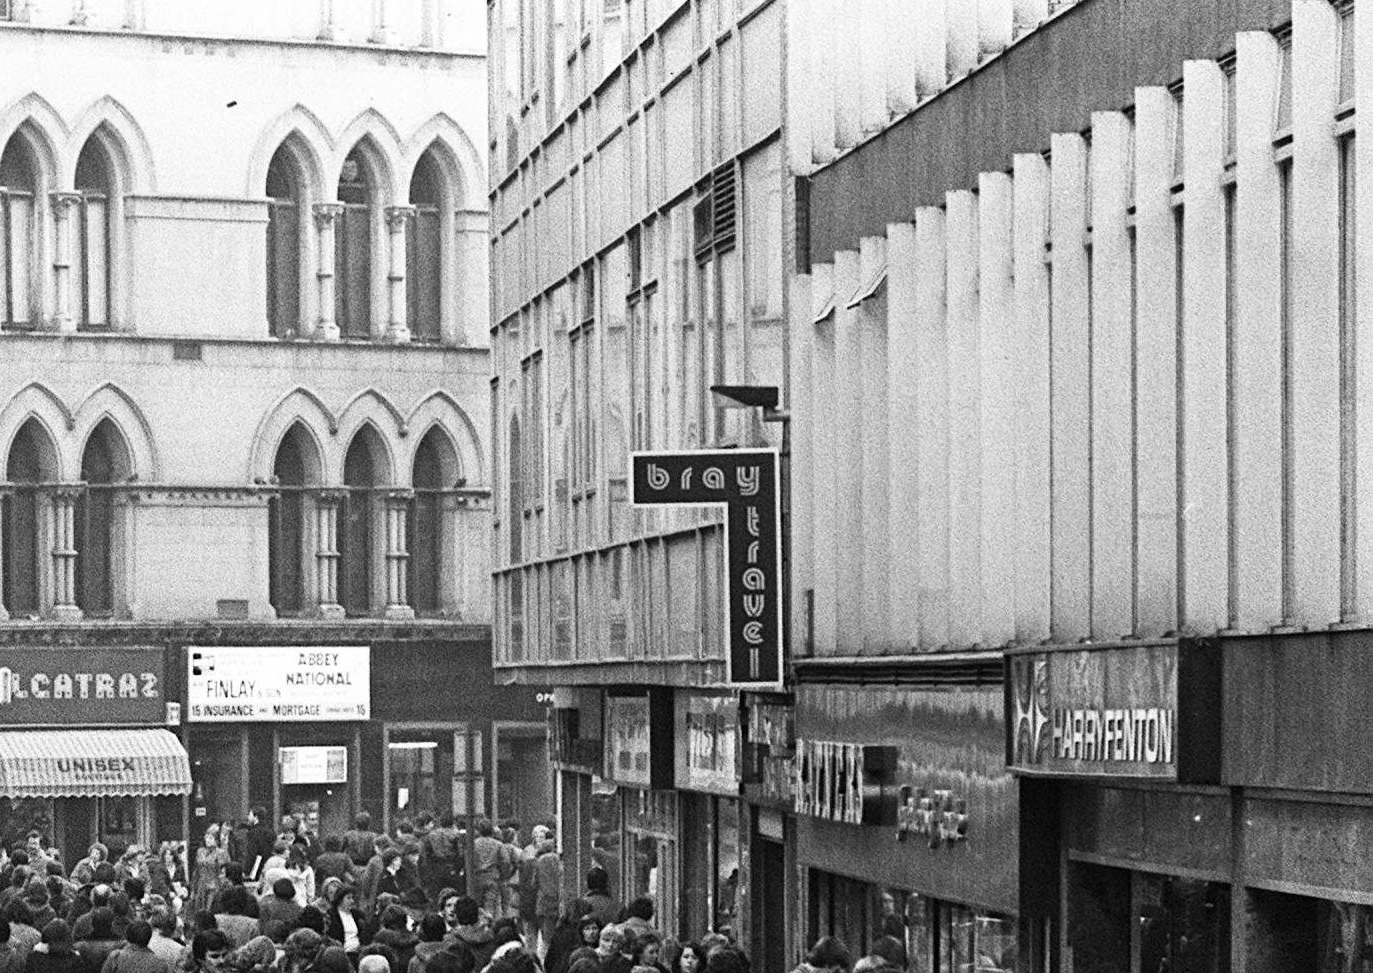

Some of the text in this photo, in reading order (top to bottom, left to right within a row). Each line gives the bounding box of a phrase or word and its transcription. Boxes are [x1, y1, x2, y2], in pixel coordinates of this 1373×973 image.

[646, 463, 760, 496] bray
[742, 506, 765, 679] travel
[298, 653, 339, 666] ABBEY
[286, 673, 352, 686] NATIONAL
[207, 680, 256, 698] FINLAY
[204, 704, 254, 717] INSURANCE
[273, 704, 321, 717] MORTGAGE
[56, 758, 135, 773] UNISEX
